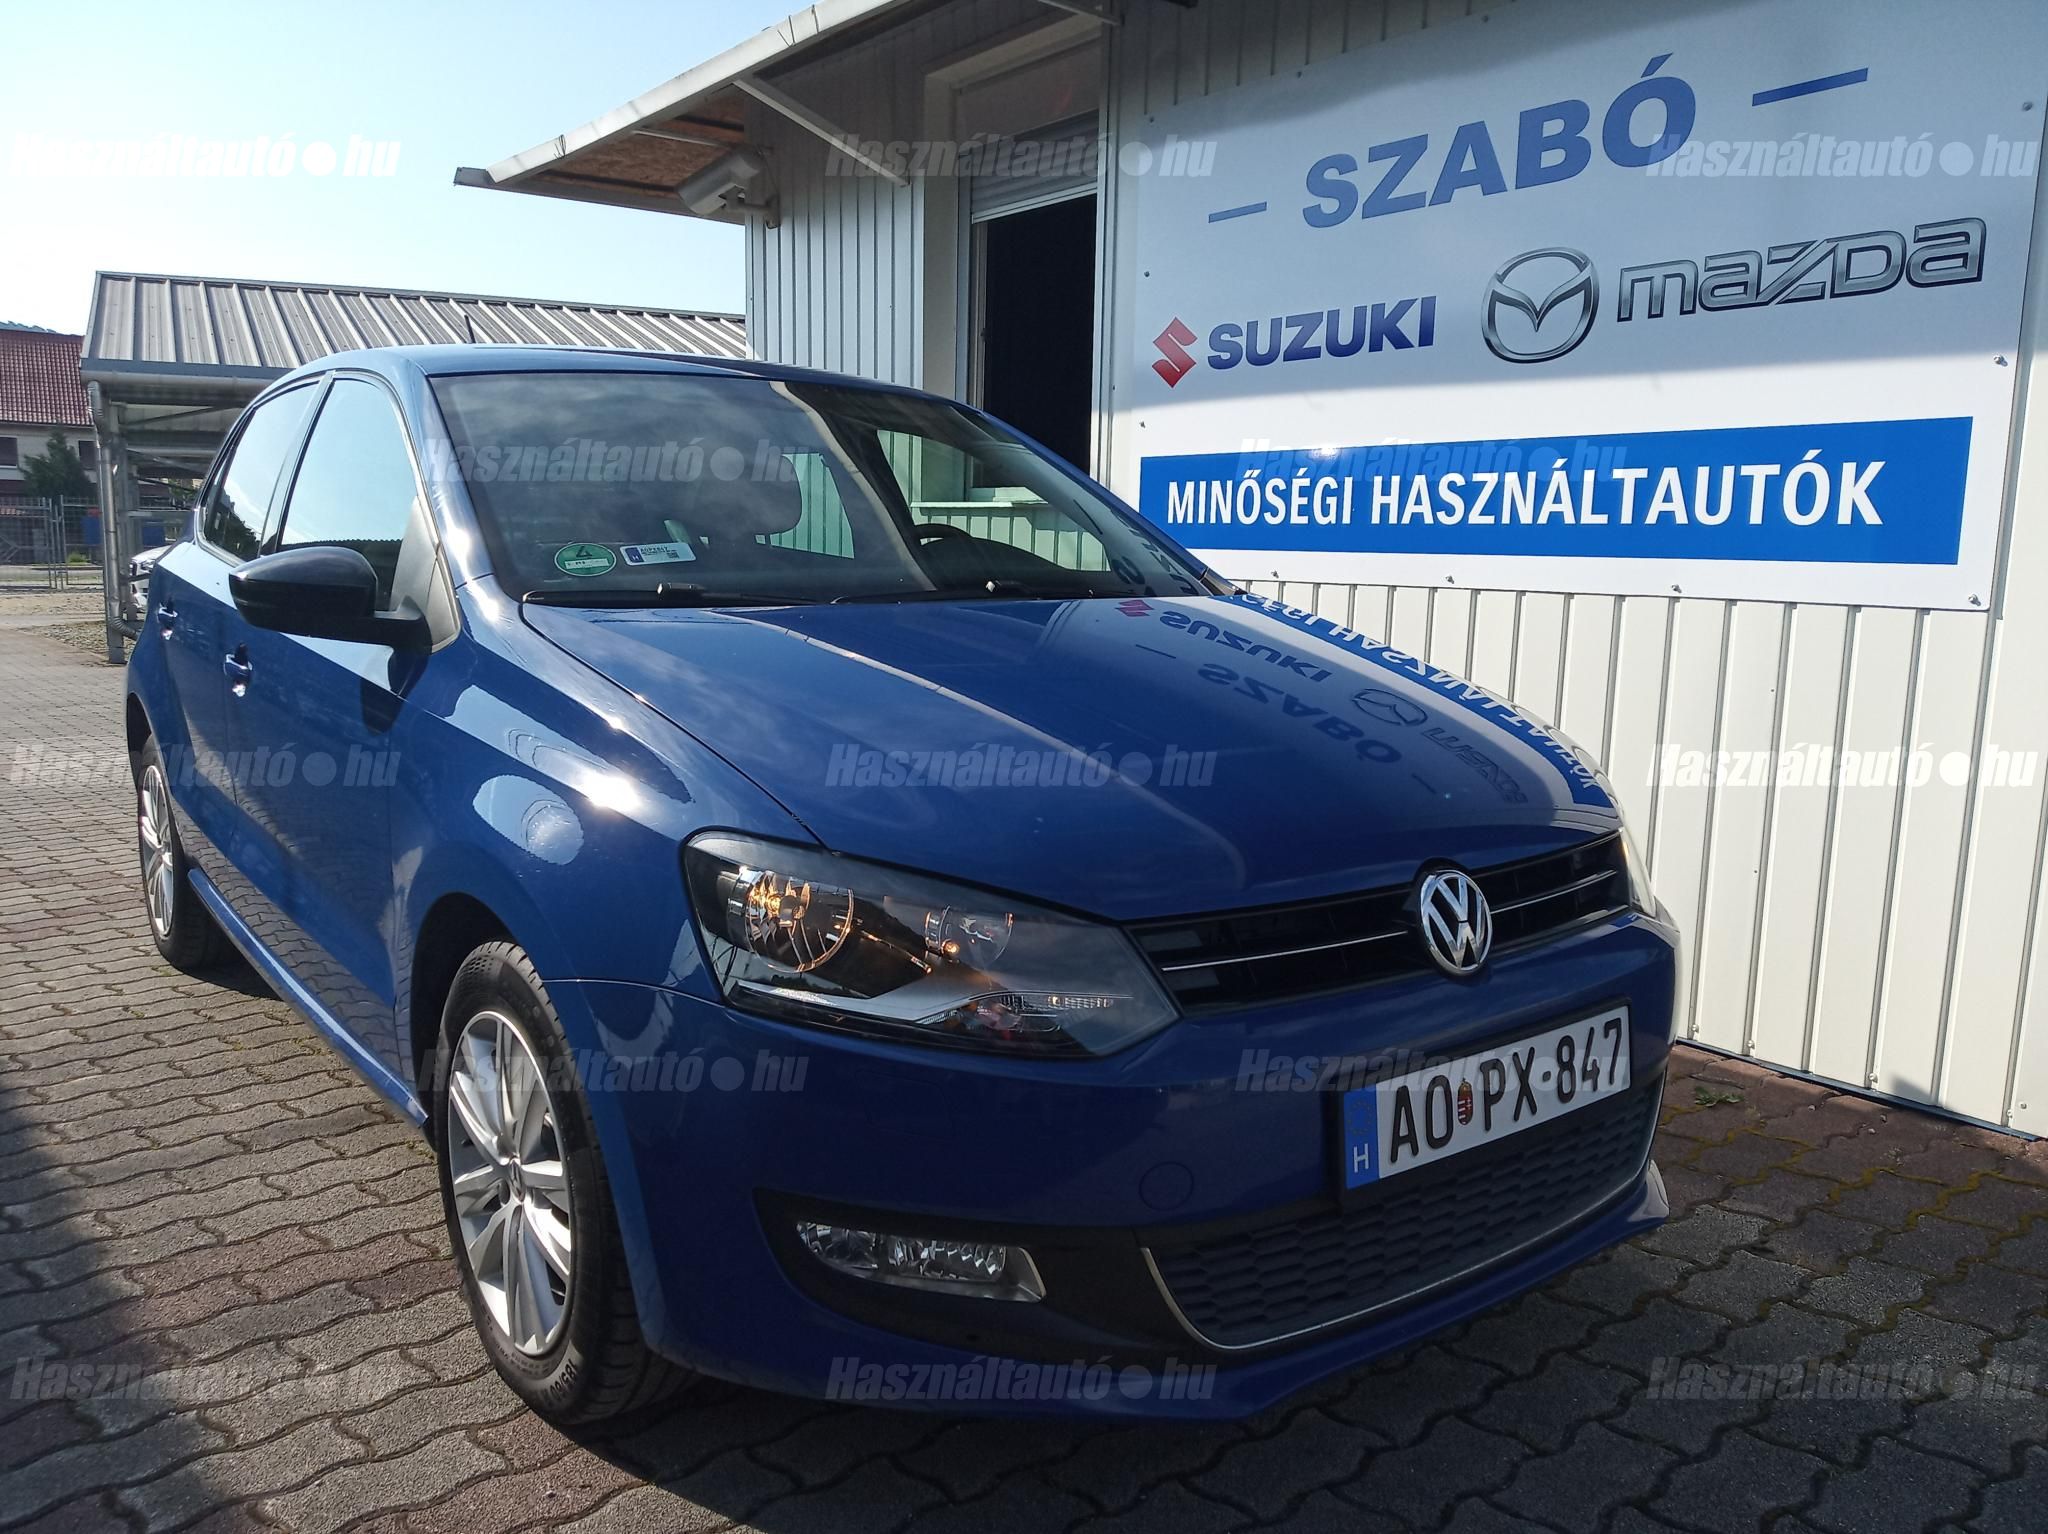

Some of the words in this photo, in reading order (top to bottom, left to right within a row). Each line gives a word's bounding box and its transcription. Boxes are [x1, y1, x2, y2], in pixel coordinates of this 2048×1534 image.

[1302, 52, 1697, 229] SZABÓ
[1617, 216, 1987, 322] mazda
[1207, 295, 1437, 370] SUZUKI
[1167, 457, 1354, 527] MINŐSÉGI
[1371, 449, 1886, 527] HASZNÁLTAUTÓK
[1353, 1143, 1370, 1174] H
